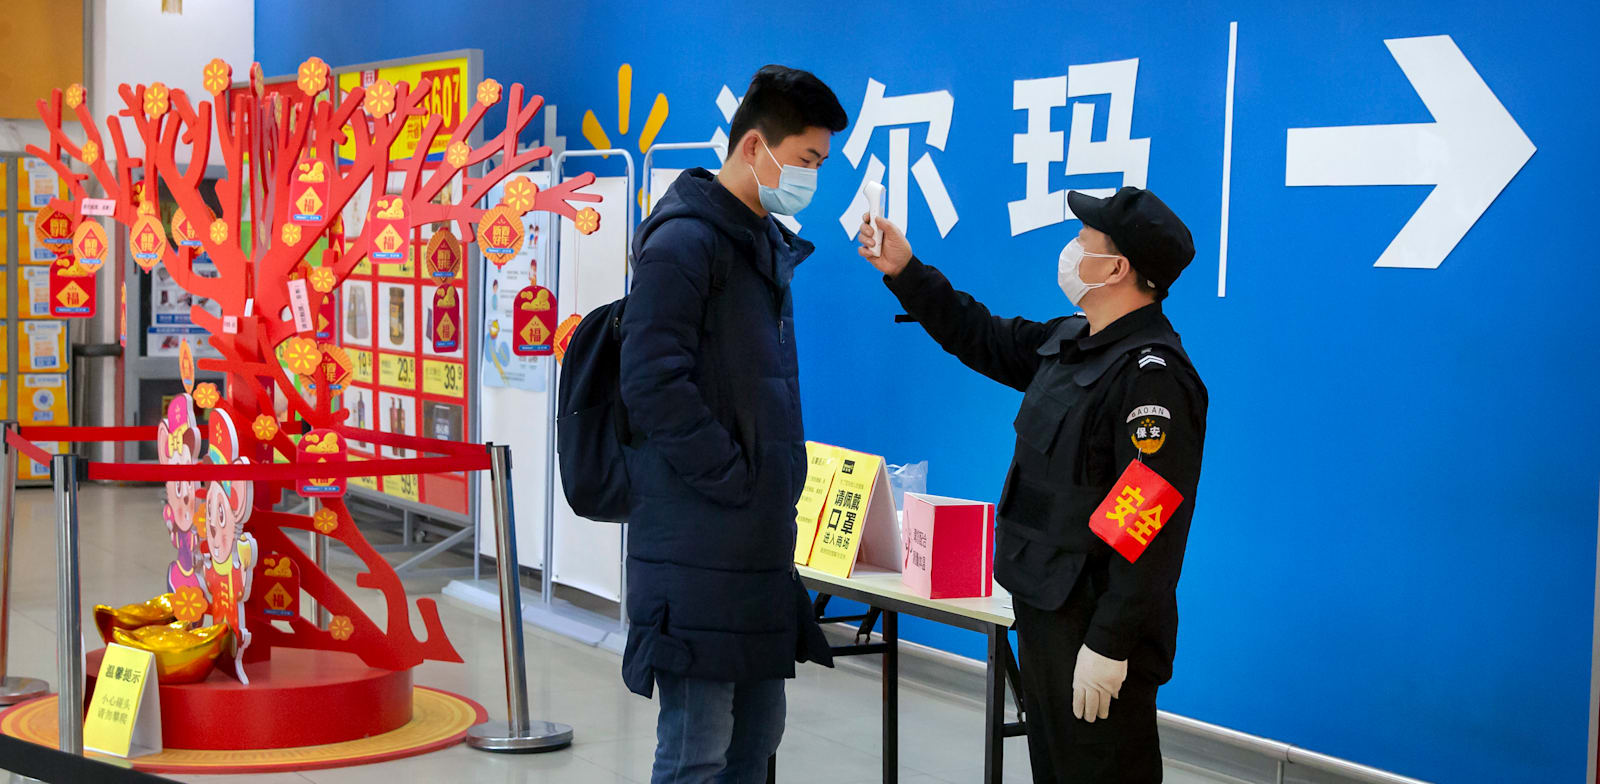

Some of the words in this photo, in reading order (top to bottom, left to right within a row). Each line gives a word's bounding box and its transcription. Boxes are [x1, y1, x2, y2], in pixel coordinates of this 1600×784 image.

[715, 58, 1151, 239] 尔玛
[529, 328, 541, 342] 福
[1136, 426, 1160, 438] 保安
[834, 489, 862, 511] 请佩戴
[827, 508, 857, 535] 口罩
[1105, 485, 1163, 546] 安全
[105, 664, 141, 684] 温馨提示
